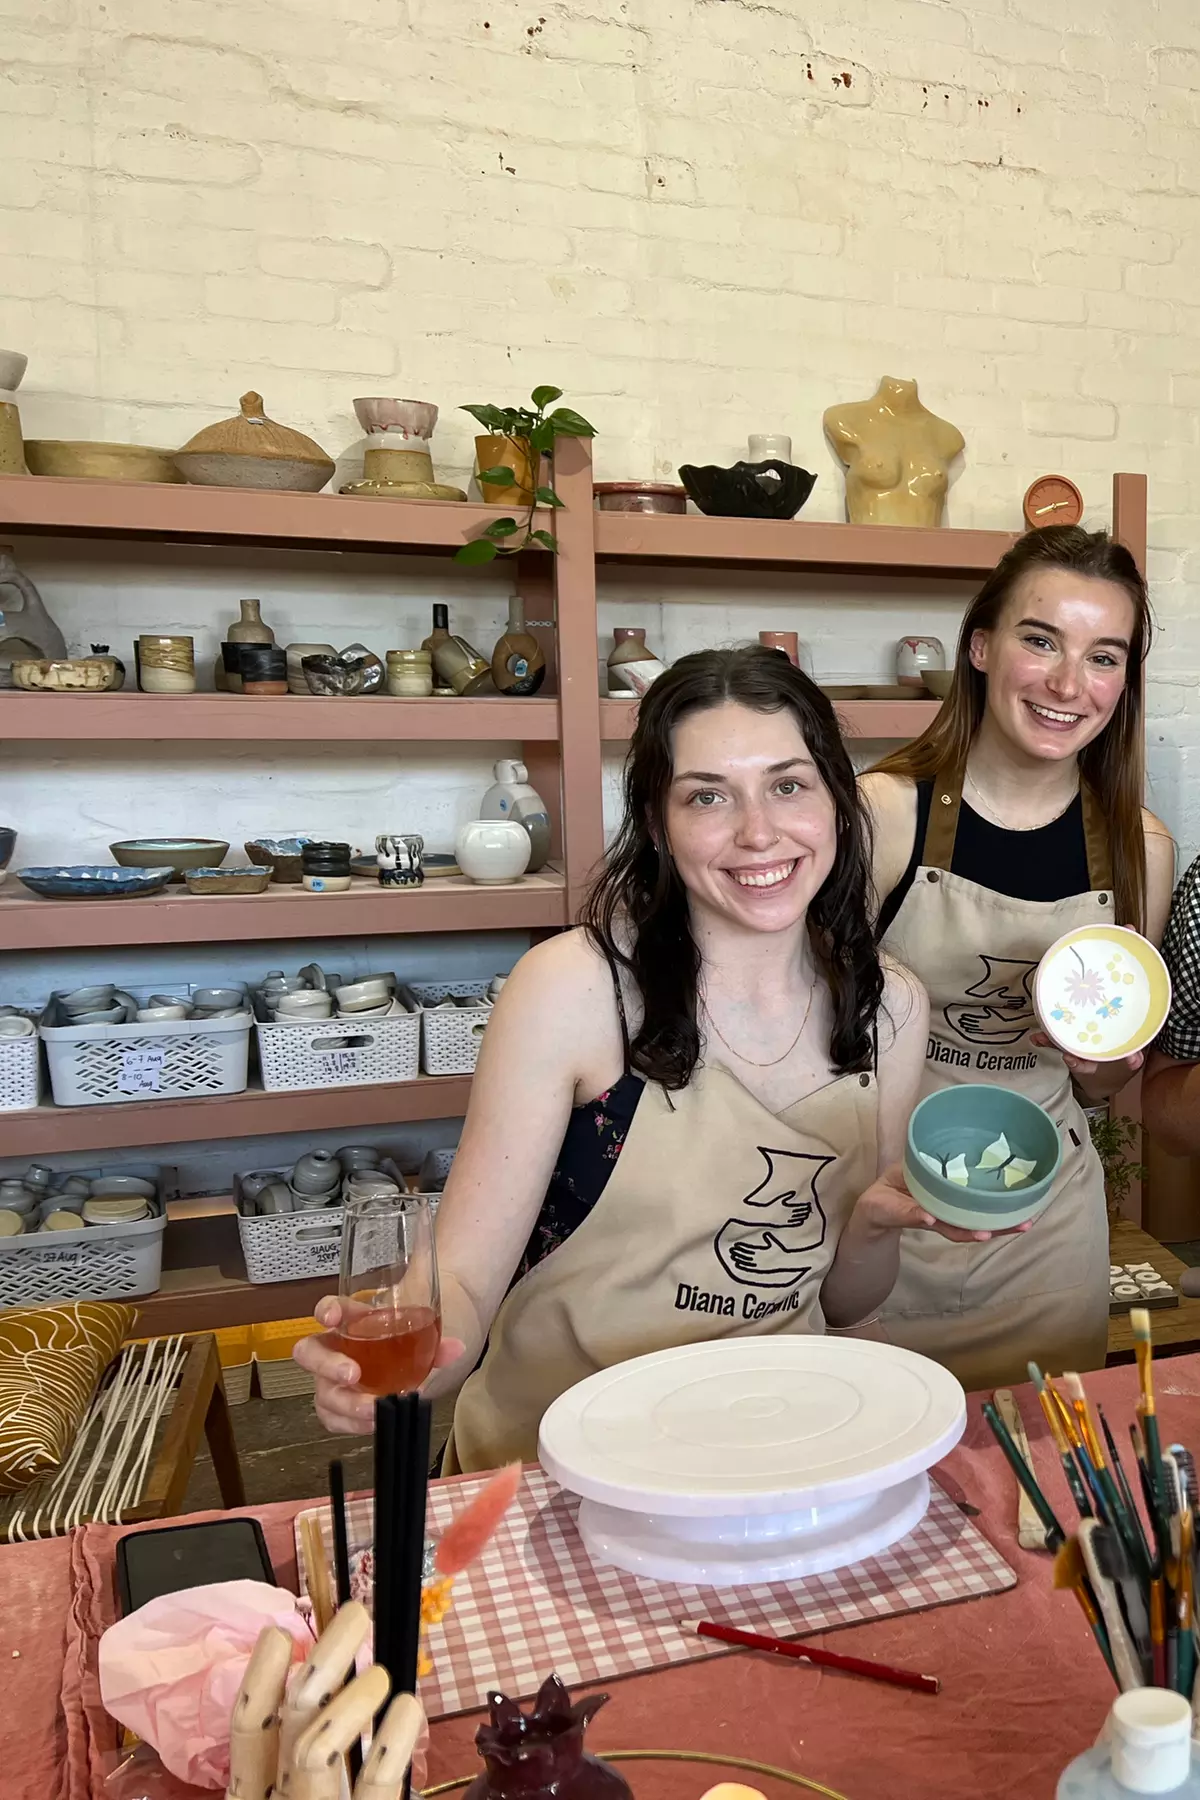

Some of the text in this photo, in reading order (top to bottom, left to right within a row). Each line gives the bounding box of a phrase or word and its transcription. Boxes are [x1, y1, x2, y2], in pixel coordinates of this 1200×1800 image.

[926, 1038, 1038, 1071] Diana Ceramic
[674, 1283, 736, 1317] Diana
